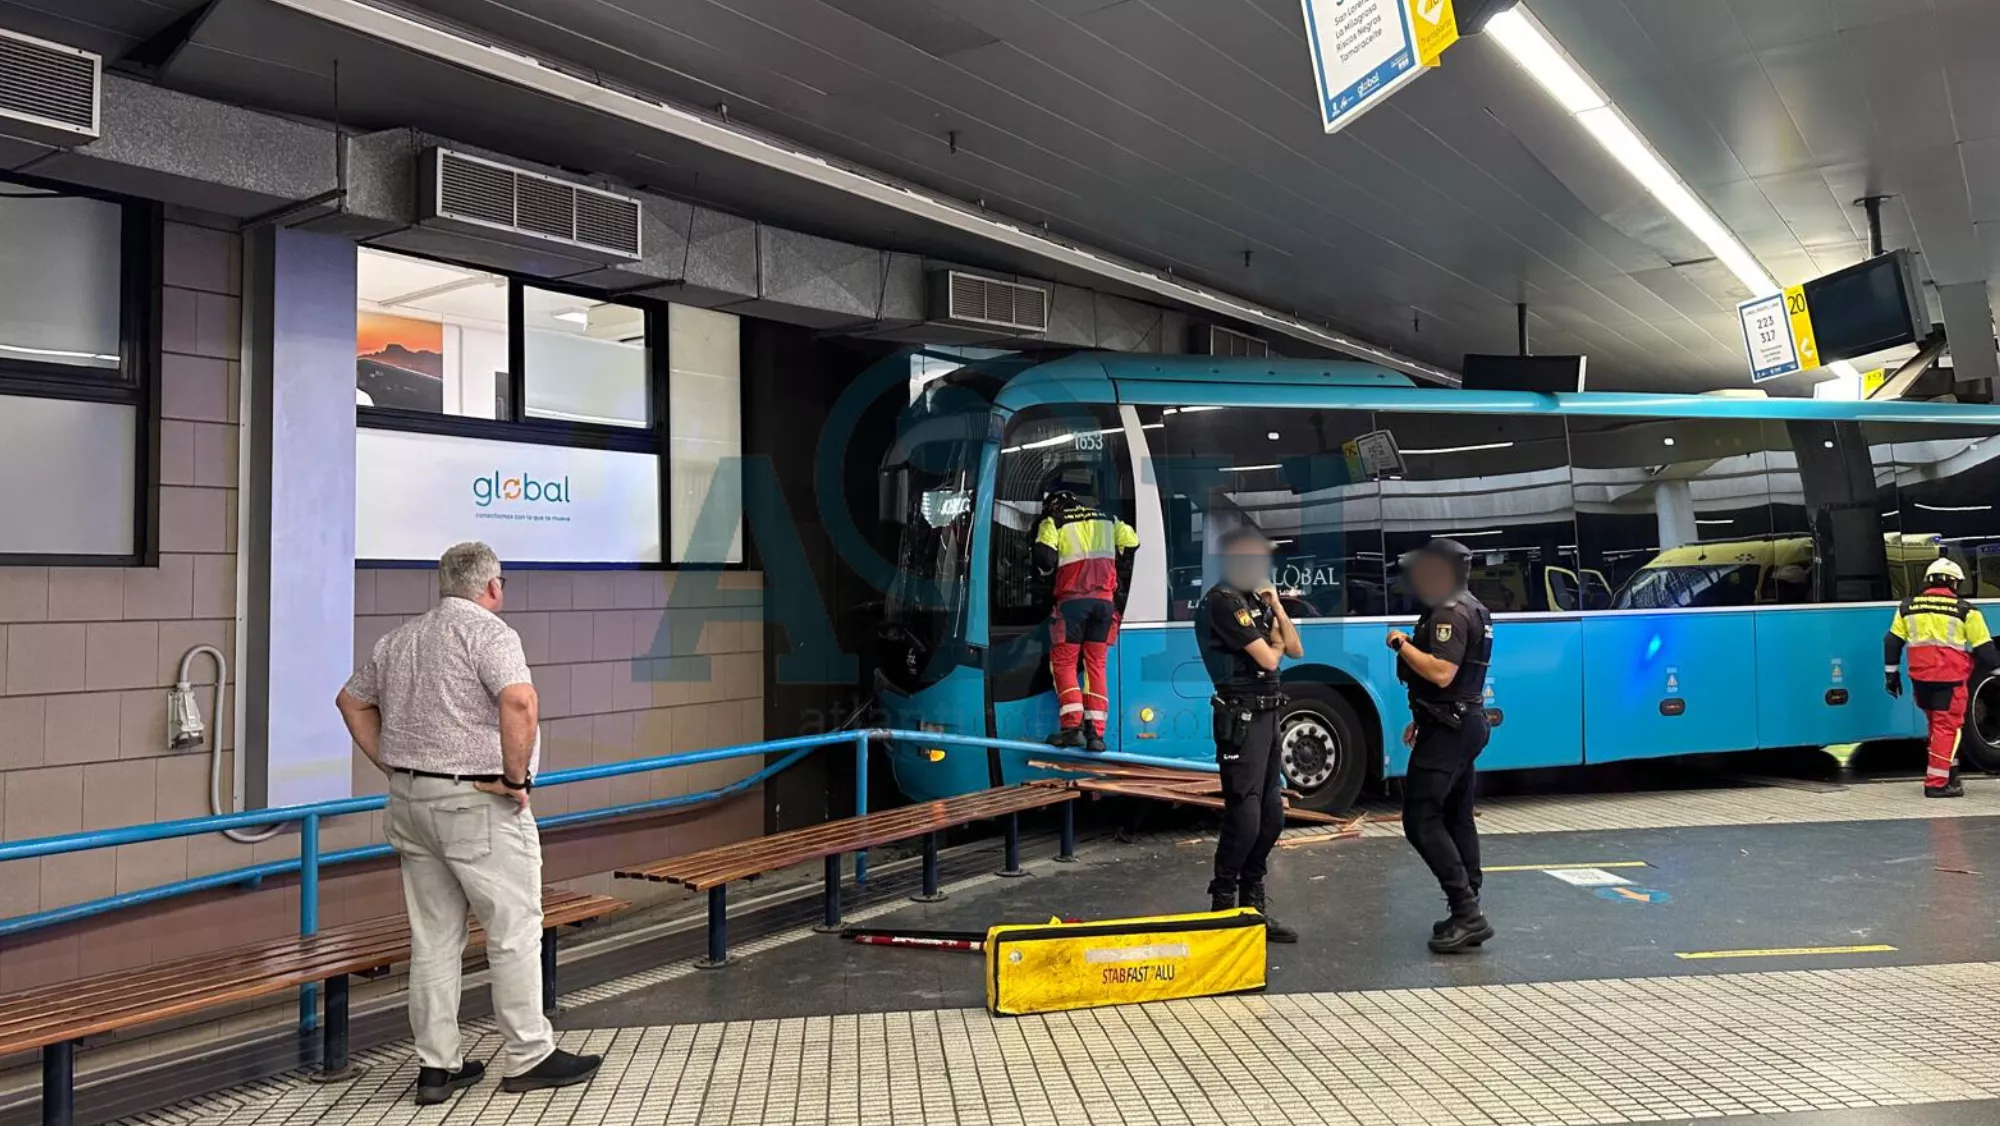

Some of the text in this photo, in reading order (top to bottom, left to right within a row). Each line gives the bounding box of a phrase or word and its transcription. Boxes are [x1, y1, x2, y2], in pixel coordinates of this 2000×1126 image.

[1787, 293, 1805, 315] 20
[1757, 315, 1774, 329] 223
[1760, 329, 1776, 343] 317
[1074, 431, 1103, 450] 1653
[473, 470, 570, 506] global
[1272, 564, 1340, 588] LOBAL
